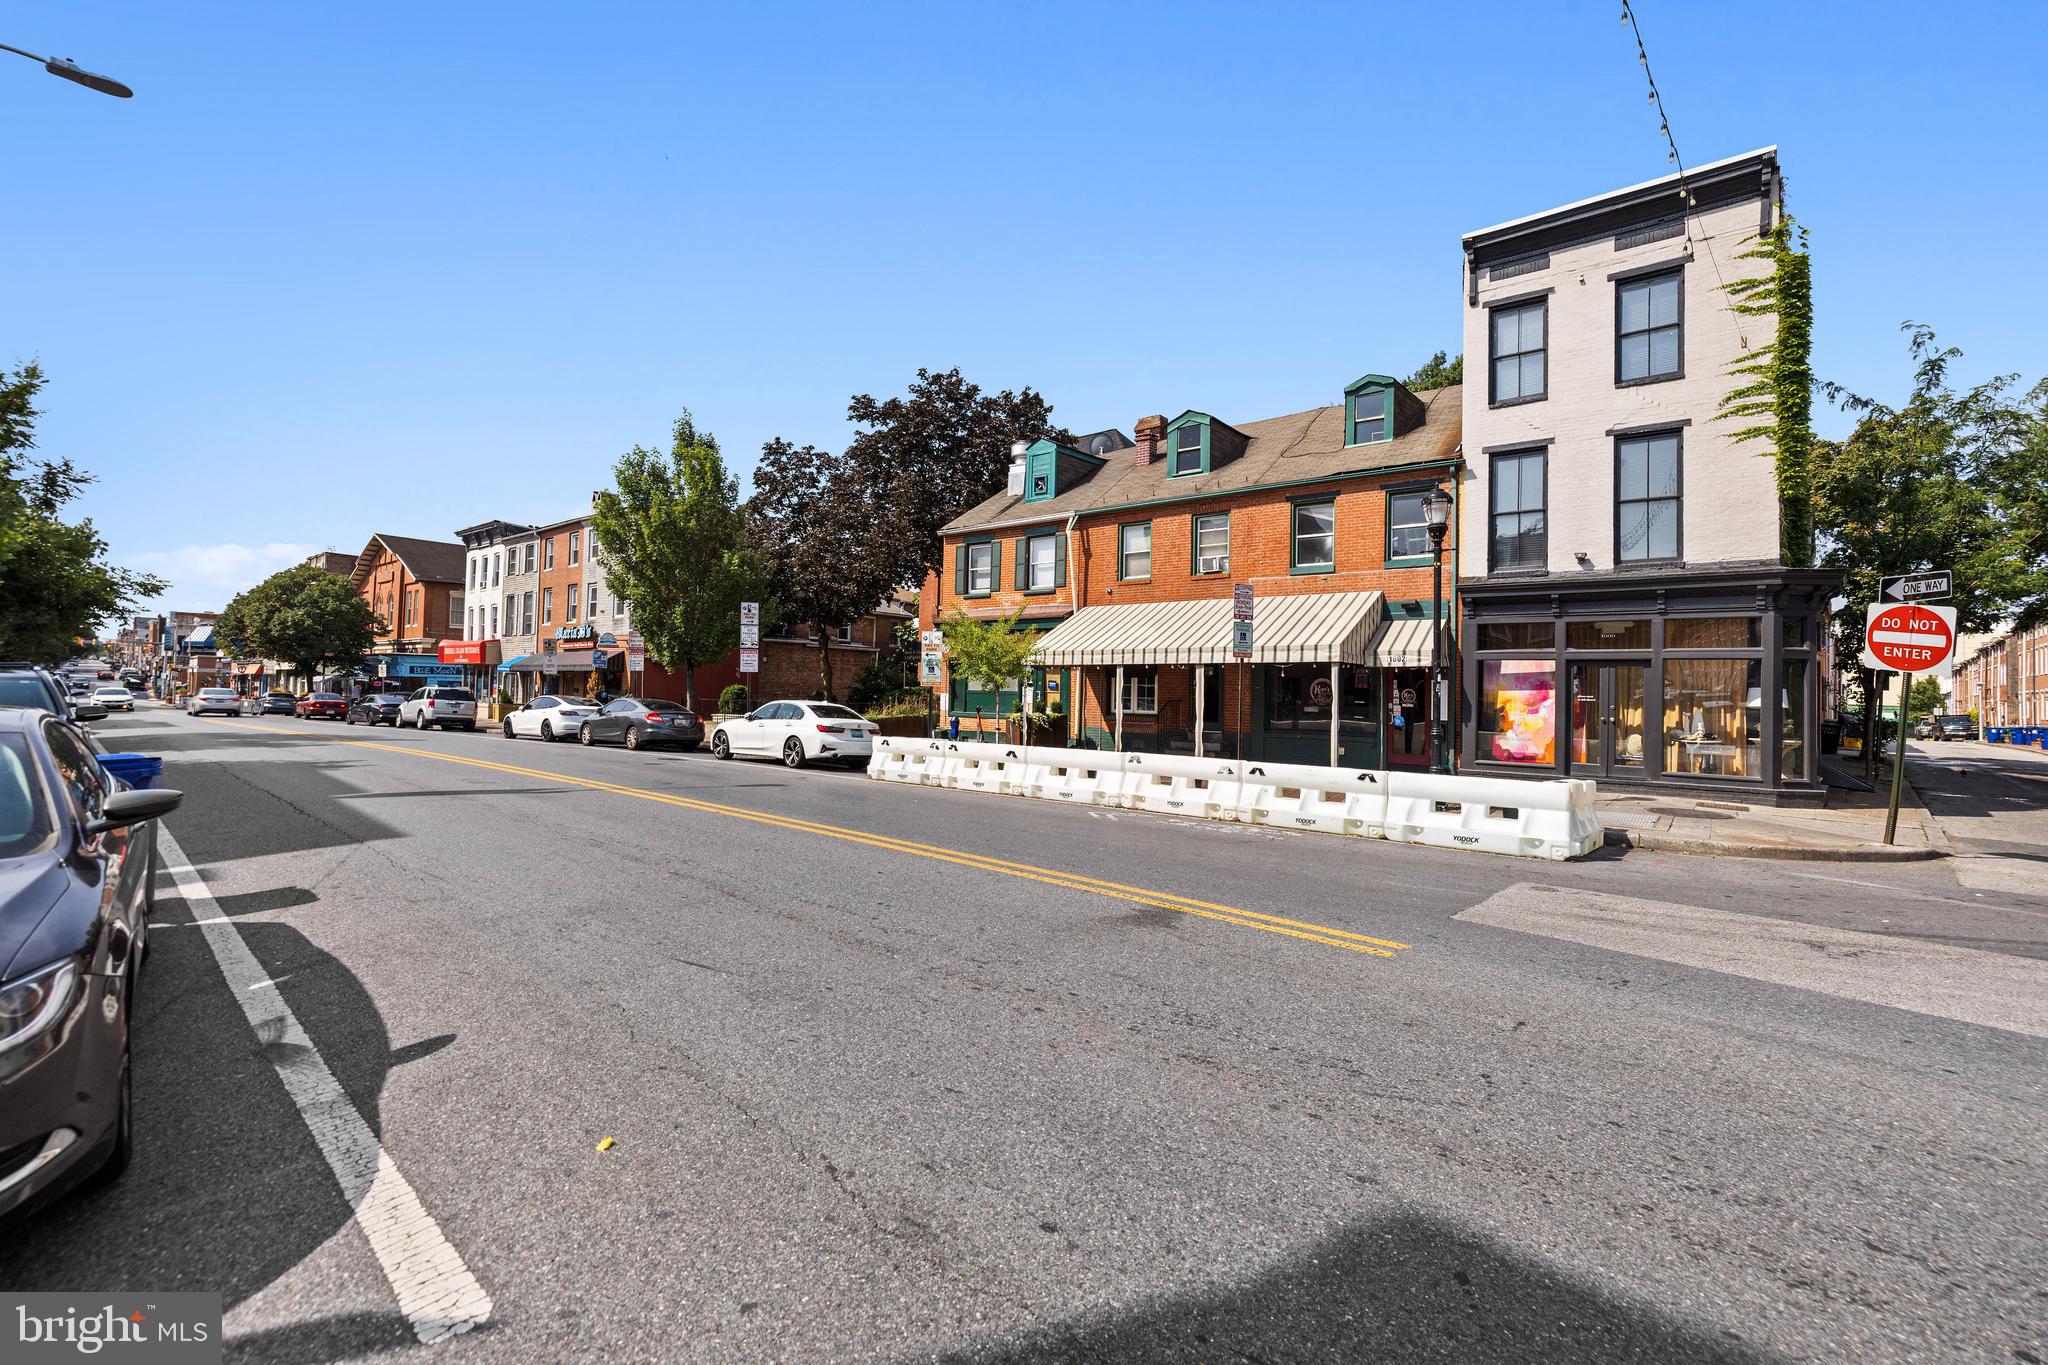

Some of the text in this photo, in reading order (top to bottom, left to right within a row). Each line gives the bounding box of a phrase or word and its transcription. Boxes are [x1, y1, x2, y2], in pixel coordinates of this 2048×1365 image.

[1902, 580, 1944, 594] ONE WAY
[1881, 617, 1938, 631] DO NOT
[1884, 646, 1932, 660] ENTER
[1453, 835, 1480, 843] YODOCK
